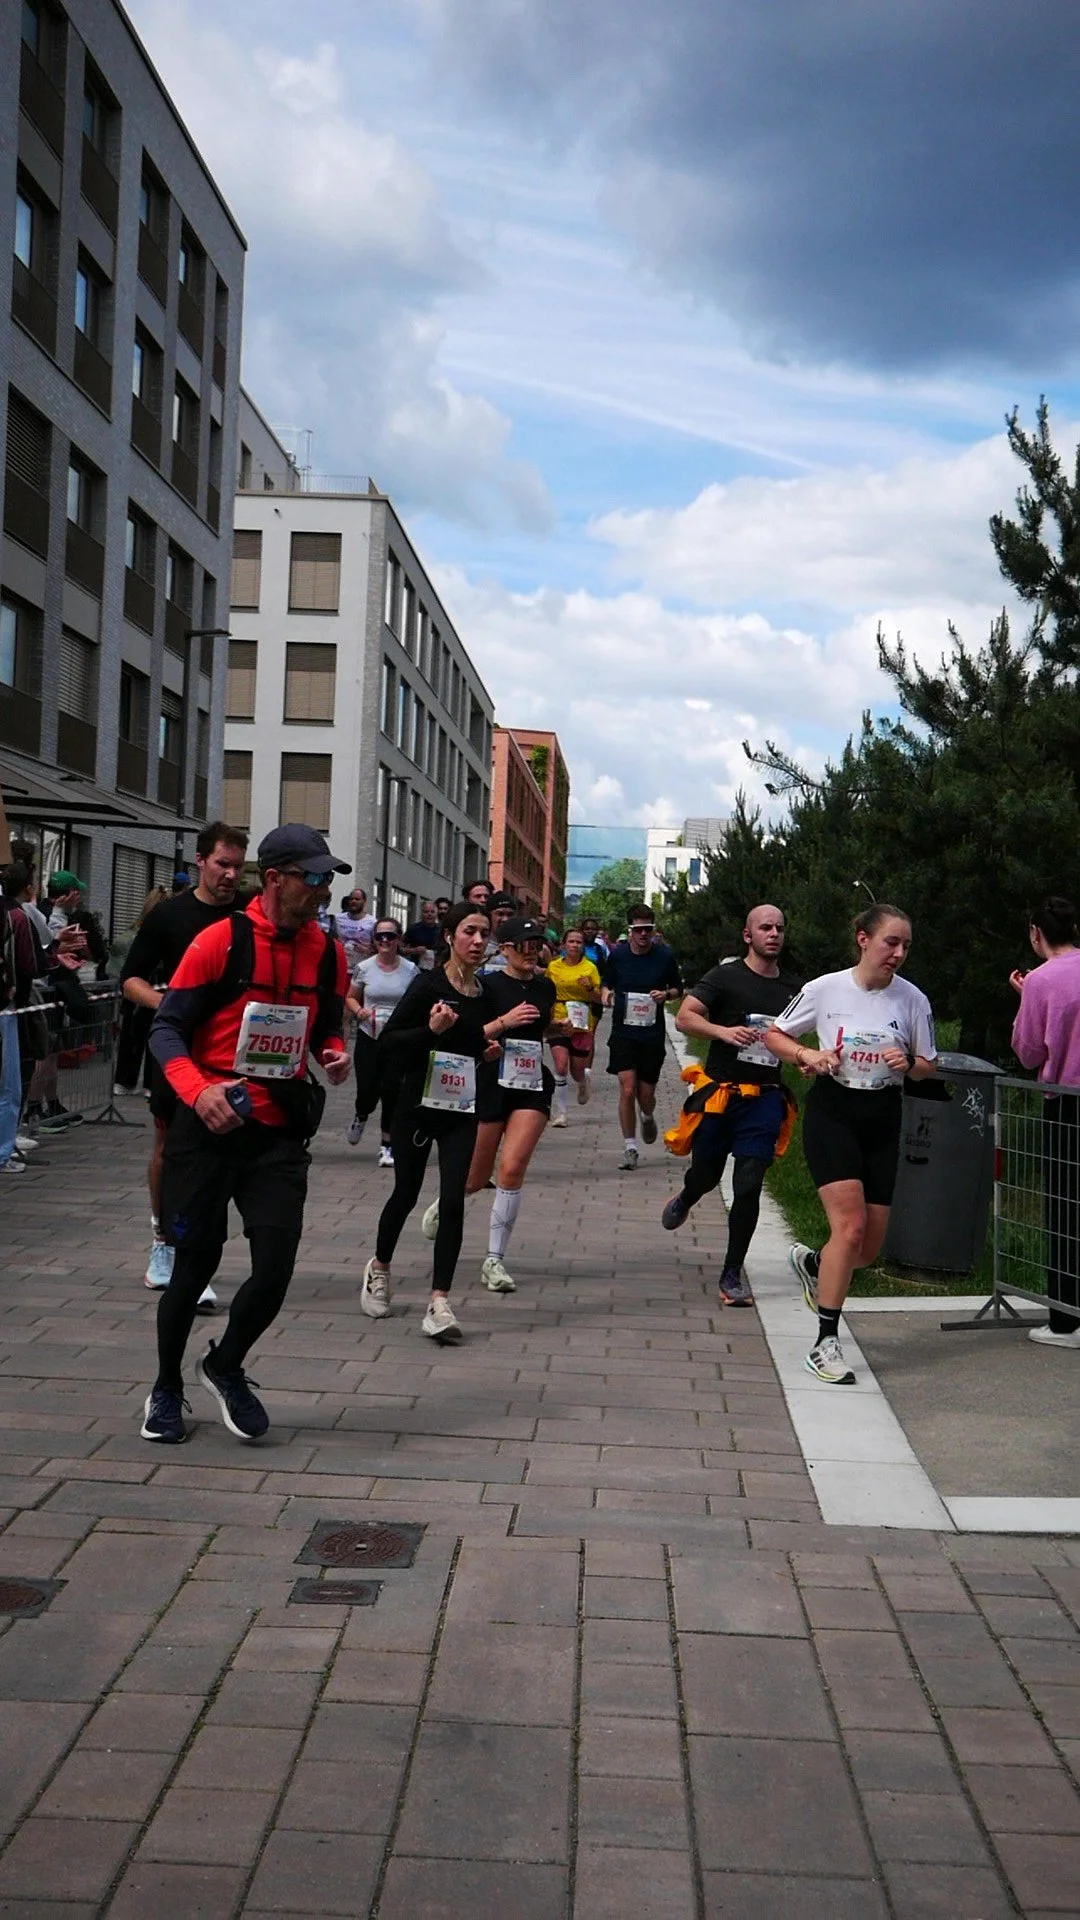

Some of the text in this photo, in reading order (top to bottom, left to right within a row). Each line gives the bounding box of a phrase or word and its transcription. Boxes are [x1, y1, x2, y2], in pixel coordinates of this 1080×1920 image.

[248, 1034, 302, 1054] 75031
[514, 1058, 536, 1069] 1361
[850, 1051, 880, 1064] 4741
[441, 1073, 466, 1087] 8131
